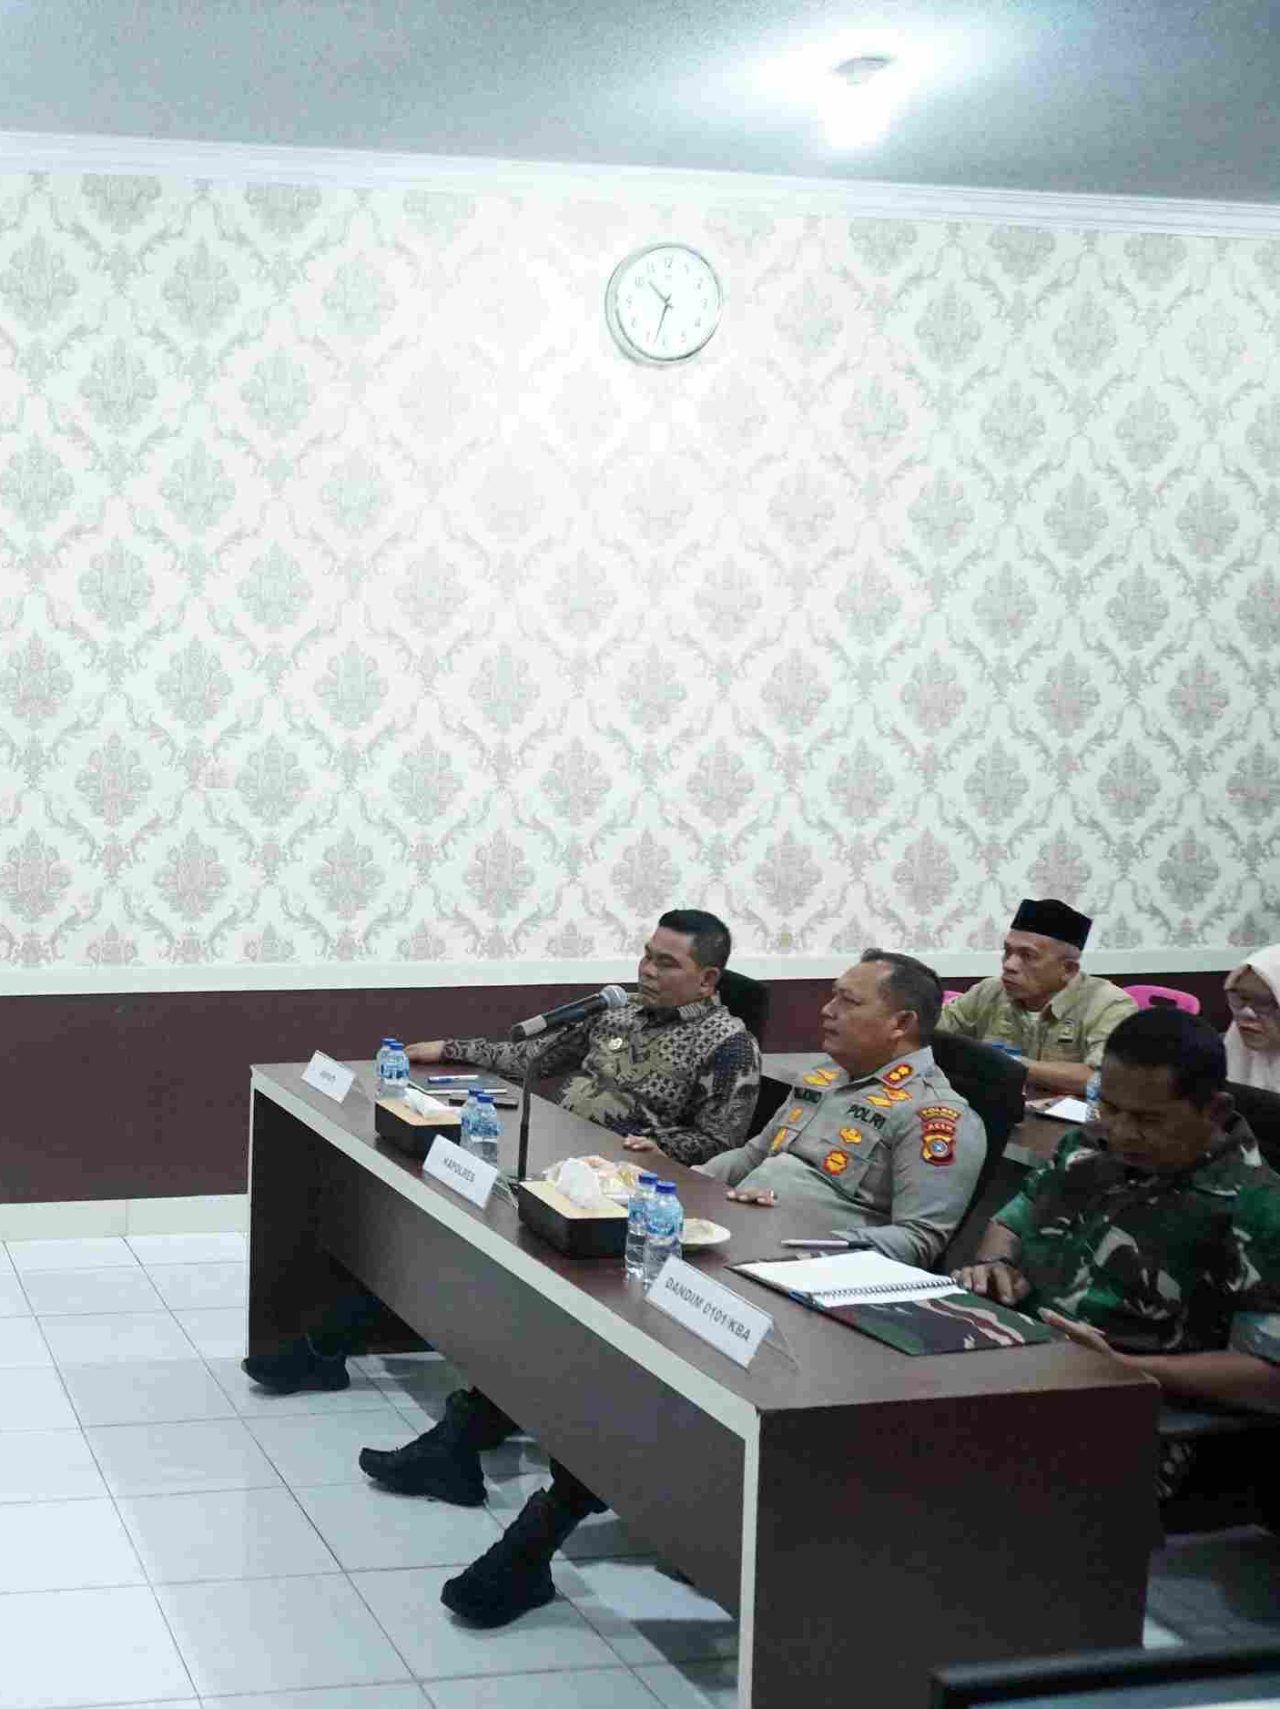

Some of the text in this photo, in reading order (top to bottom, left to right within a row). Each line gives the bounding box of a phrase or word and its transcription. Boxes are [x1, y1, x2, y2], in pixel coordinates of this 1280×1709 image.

[847, 1104, 887, 1130] POLRI
[444, 1157, 475, 1182] KAPOLRES
[665, 1277, 703, 1307] DANDIM
